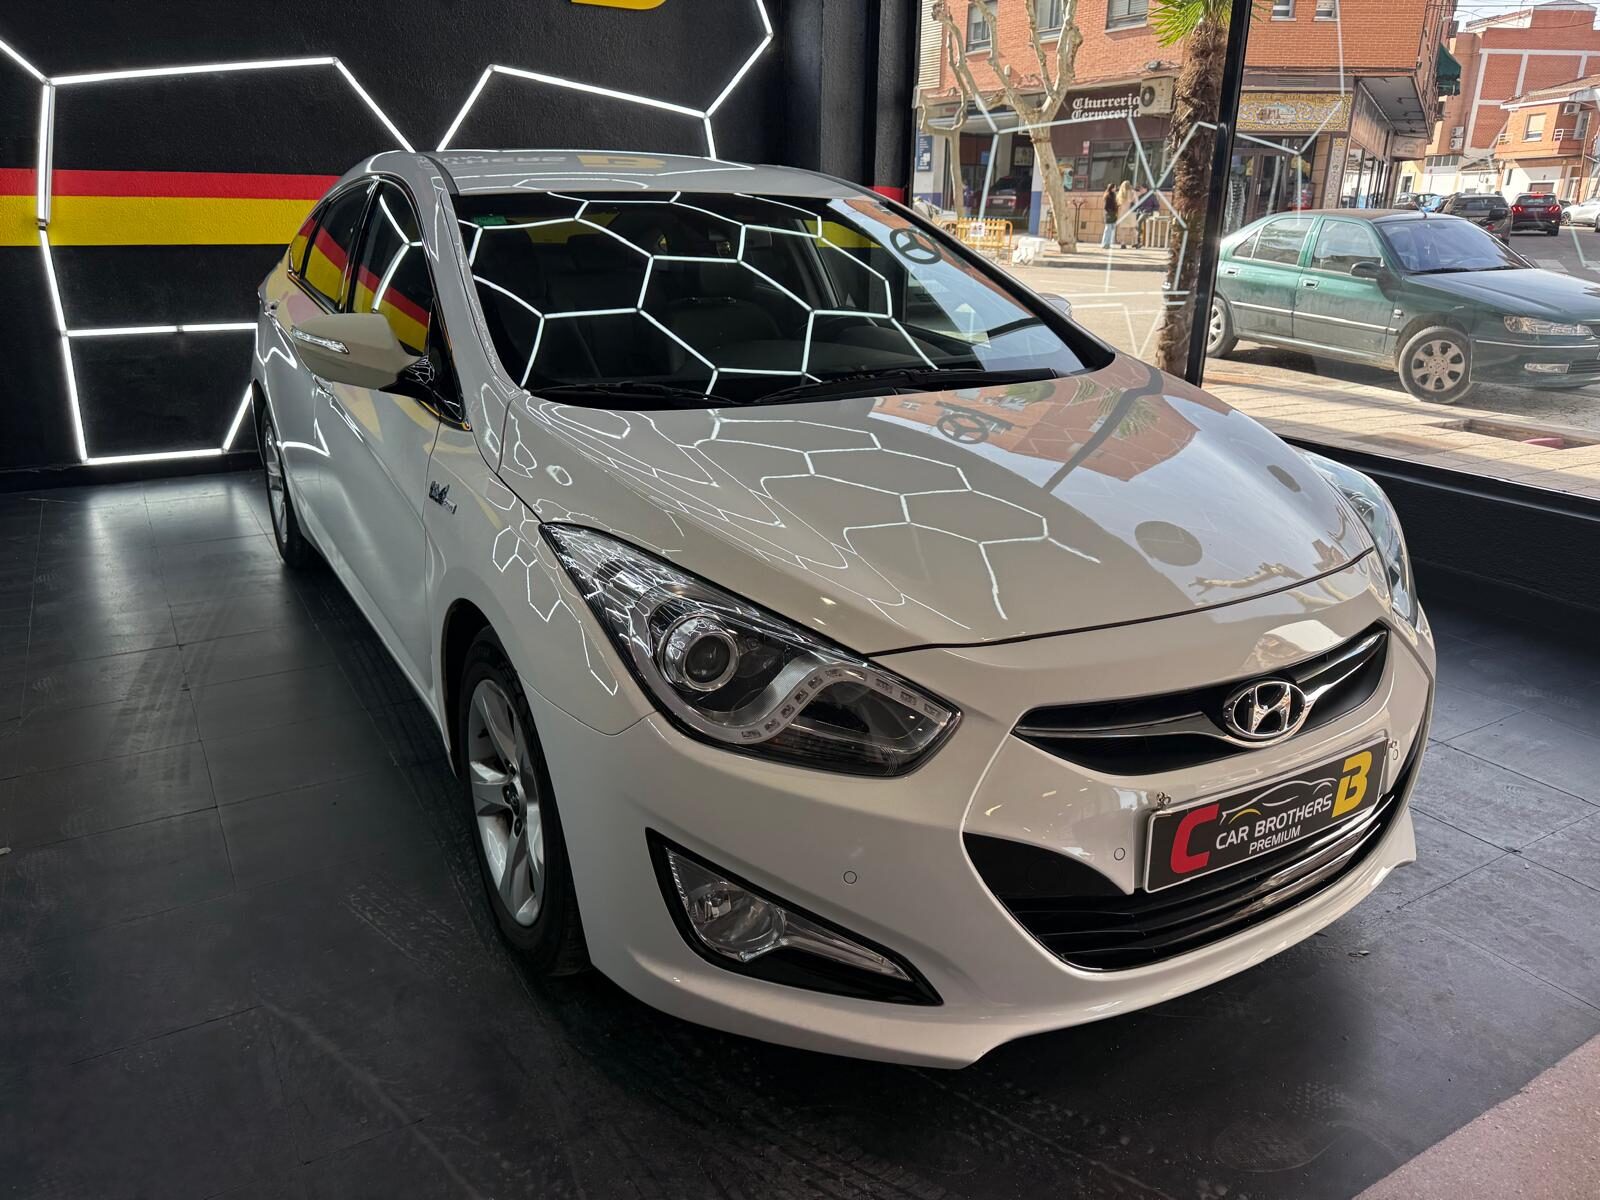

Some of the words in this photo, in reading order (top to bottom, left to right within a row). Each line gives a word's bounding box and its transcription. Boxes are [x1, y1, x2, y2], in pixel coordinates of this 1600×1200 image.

[1216, 826, 1249, 850] CAR
[1254, 793, 1333, 837] BROTHERS
[1249, 825, 1301, 855] PREMIUM
